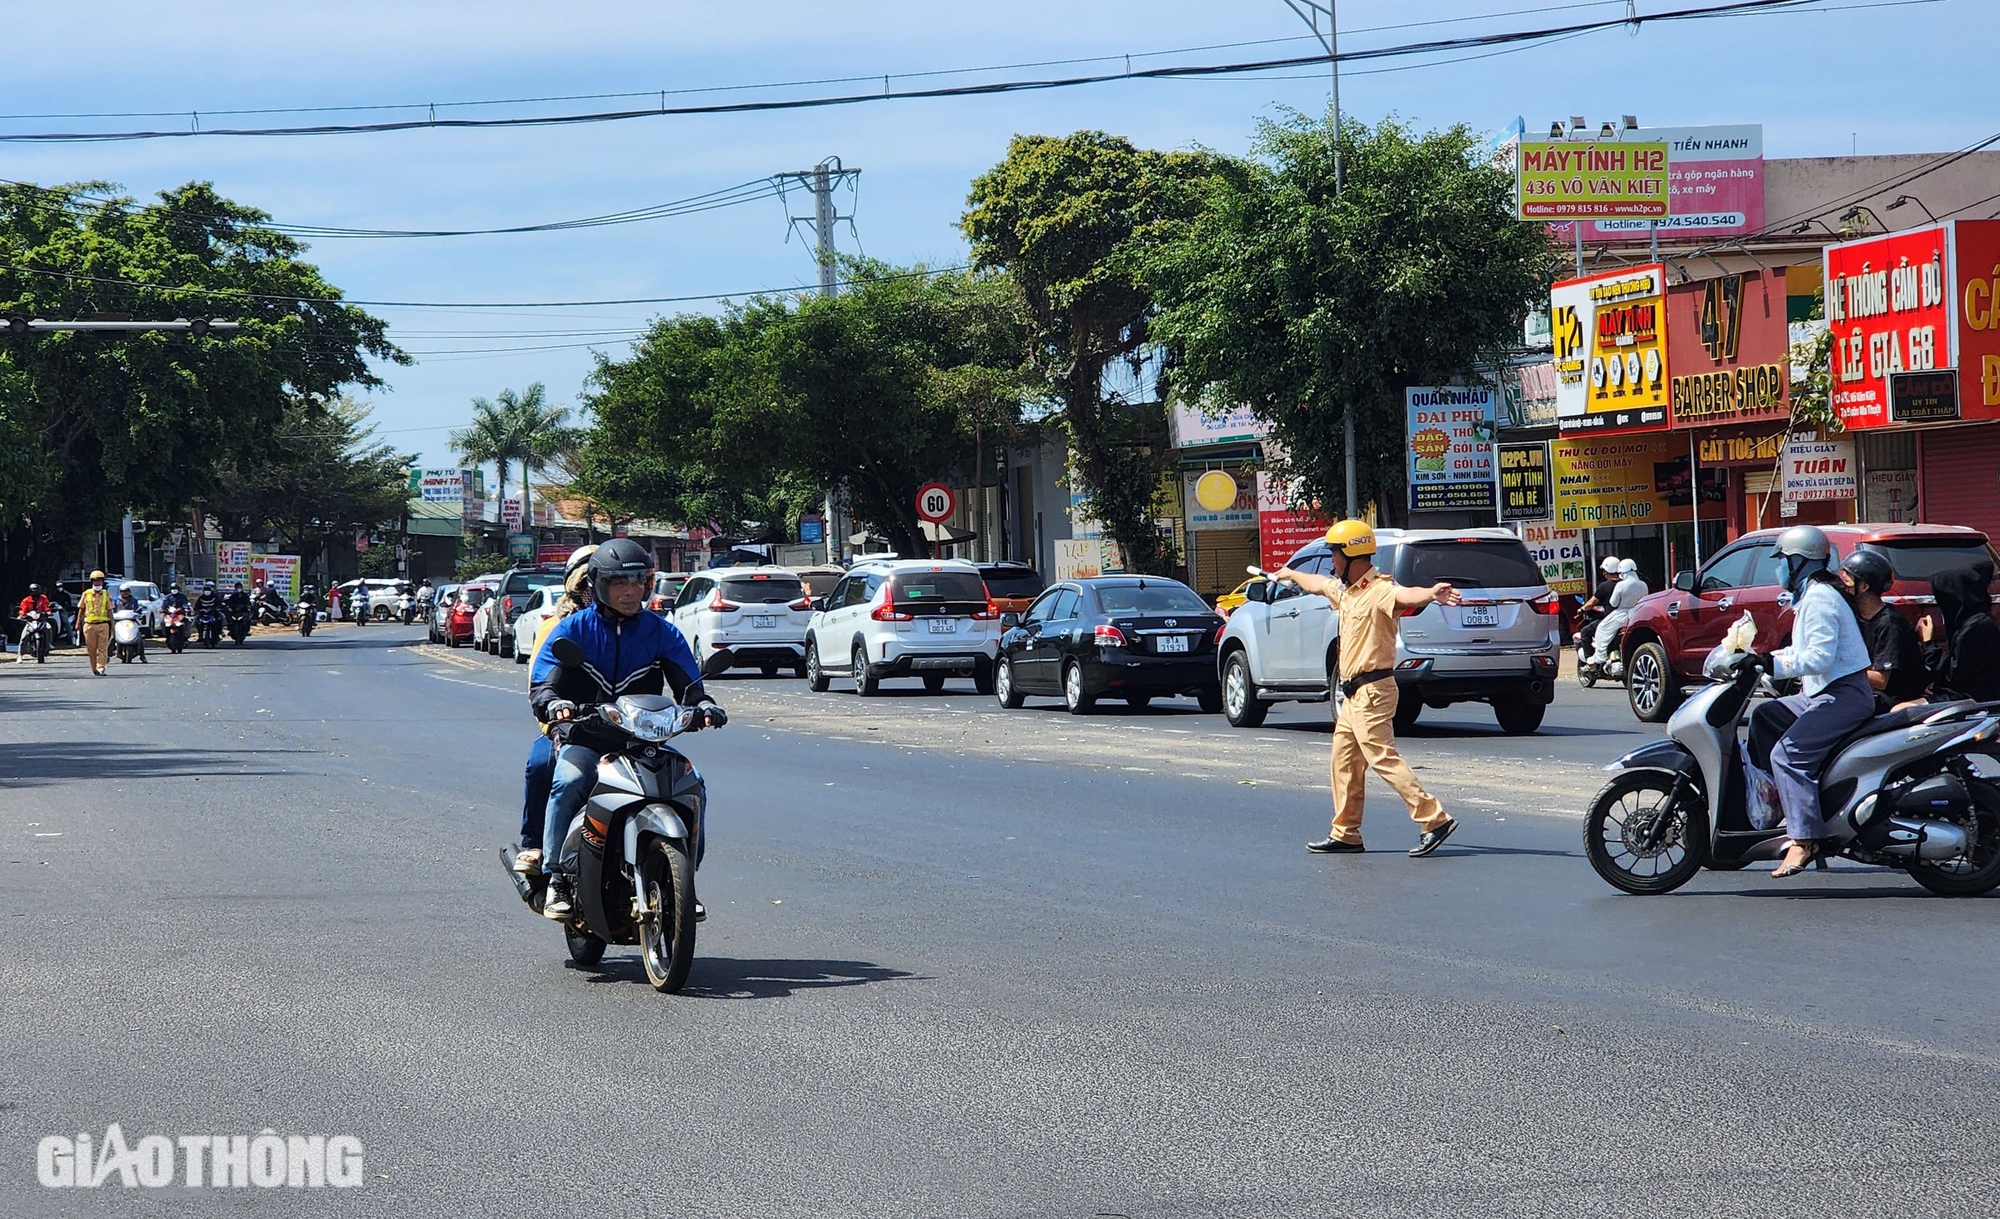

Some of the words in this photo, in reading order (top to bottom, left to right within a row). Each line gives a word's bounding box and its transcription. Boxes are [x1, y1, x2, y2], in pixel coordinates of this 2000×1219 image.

[1674, 136, 1701, 151] TIỀN
[1704, 138, 1748, 150] NHANH
[1633, 149, 1664, 171] H2
[1684, 171, 1702, 182] góp
[1705, 169, 1728, 180] ngân
[1730, 168, 1754, 181] hàng
[1525, 179, 1555, 195] 436
[1561, 177, 1583, 195] VÕ
[1588, 177, 1622, 195] VĂN
[1627, 176, 1663, 199] KIỆT
[1682, 186, 1693, 194] xe
[1696, 184, 1717, 195] máy
[1526, 204, 1555, 214] Hotline:
[1556, 204, 1577, 213] 0979
[1577, 204, 1592, 213] 815
[1594, 204, 1609, 213] 816
[1614, 204, 1662, 215] www.h2pc.vn
[1604, 218, 1646, 230] Hotline:
[1701, 274, 1743, 361] 47
[1839, 327, 1864, 383] LÊ
[1870, 330, 1905, 379] GIA
[1909, 325, 1935, 371] 68
[1672, 370, 1735, 417] BARBER
[1735, 364, 1783, 410] SHOP
[1417, 411, 1447, 427] ĐẠI
[1451, 407, 1485, 422] PHÚ
[1558, 448, 1582, 458] THU
[1727, 431, 1756, 461] TÓC
[1790, 444, 1812, 455] HIỆU
[1814, 442, 1837, 453] GIÀY
[1415, 473, 1430, 481] KIM
[1431, 472, 1447, 481] SƠN
[1453, 471, 1472, 480] NINH
[1472, 470, 1491, 479] BÌNH
[1559, 474, 1591, 486] NHẬN
[1615, 486, 1623, 494] PC
[1803, 488, 1855, 499] 0937.138.320
[927, 495, 944, 512] 60
[1509, 490, 1526, 507] GIÁ
[1580, 505, 1603, 524] TRỢ
[1630, 502, 1652, 519] GÓP
[1473, 606, 1488, 615] 48B
[1467, 615, 1494, 624] 008.91
